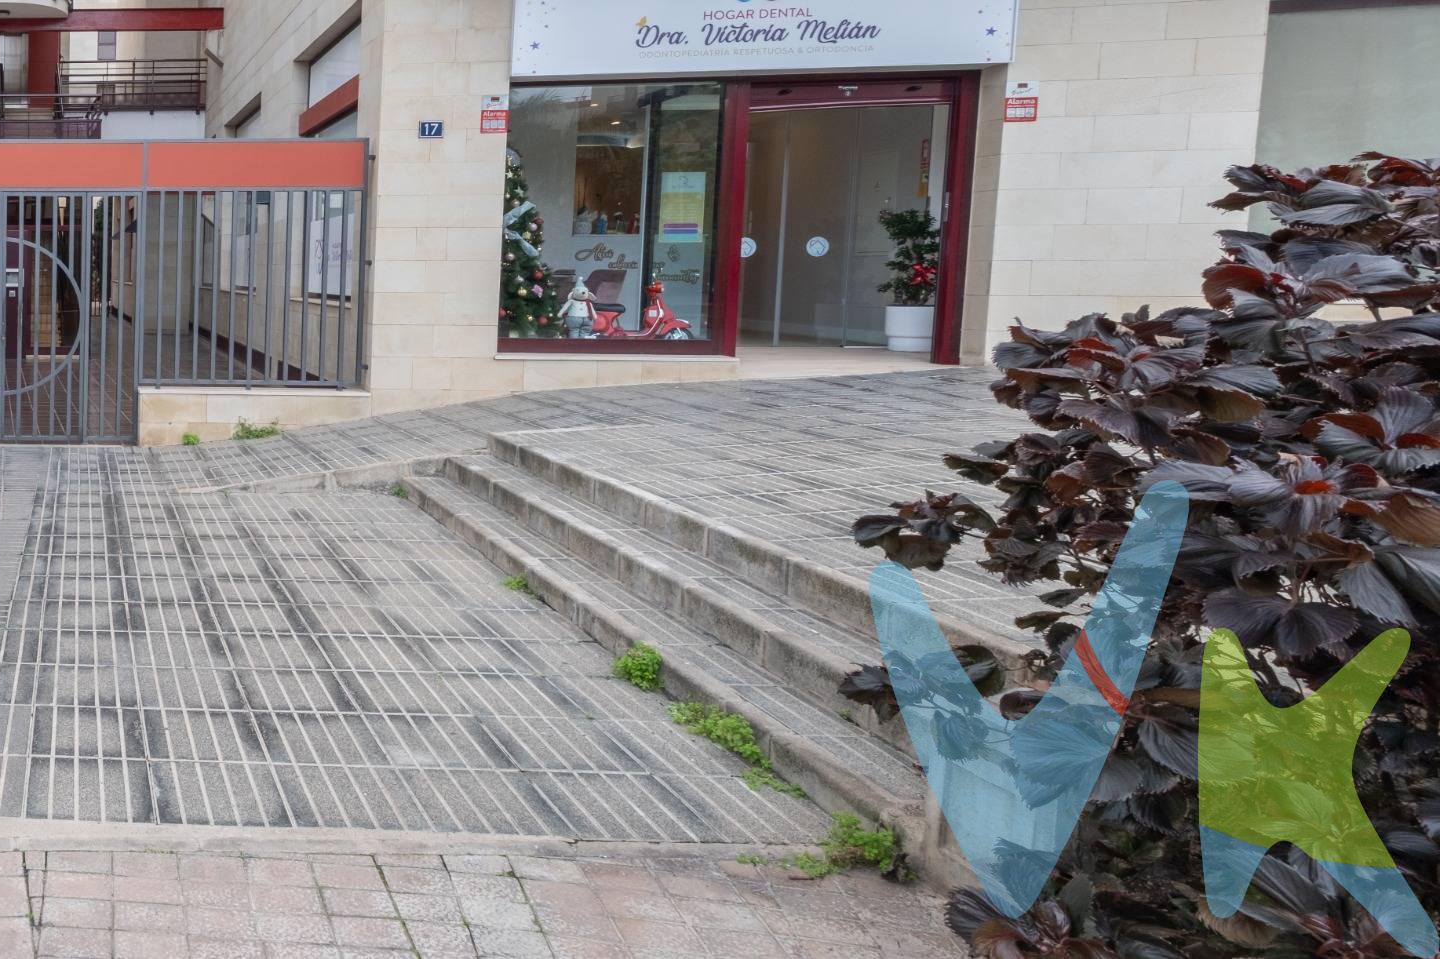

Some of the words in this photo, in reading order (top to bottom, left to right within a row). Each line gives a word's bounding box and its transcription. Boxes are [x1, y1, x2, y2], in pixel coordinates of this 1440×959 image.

[703, 9, 755, 21] HOGAR
[760, 7, 813, 19] DENTAL
[635, 24, 689, 49] Dra.
[701, 21, 789, 46] Victoria
[797, 18, 881, 44] Melián
[424, 123, 439, 135] 17
